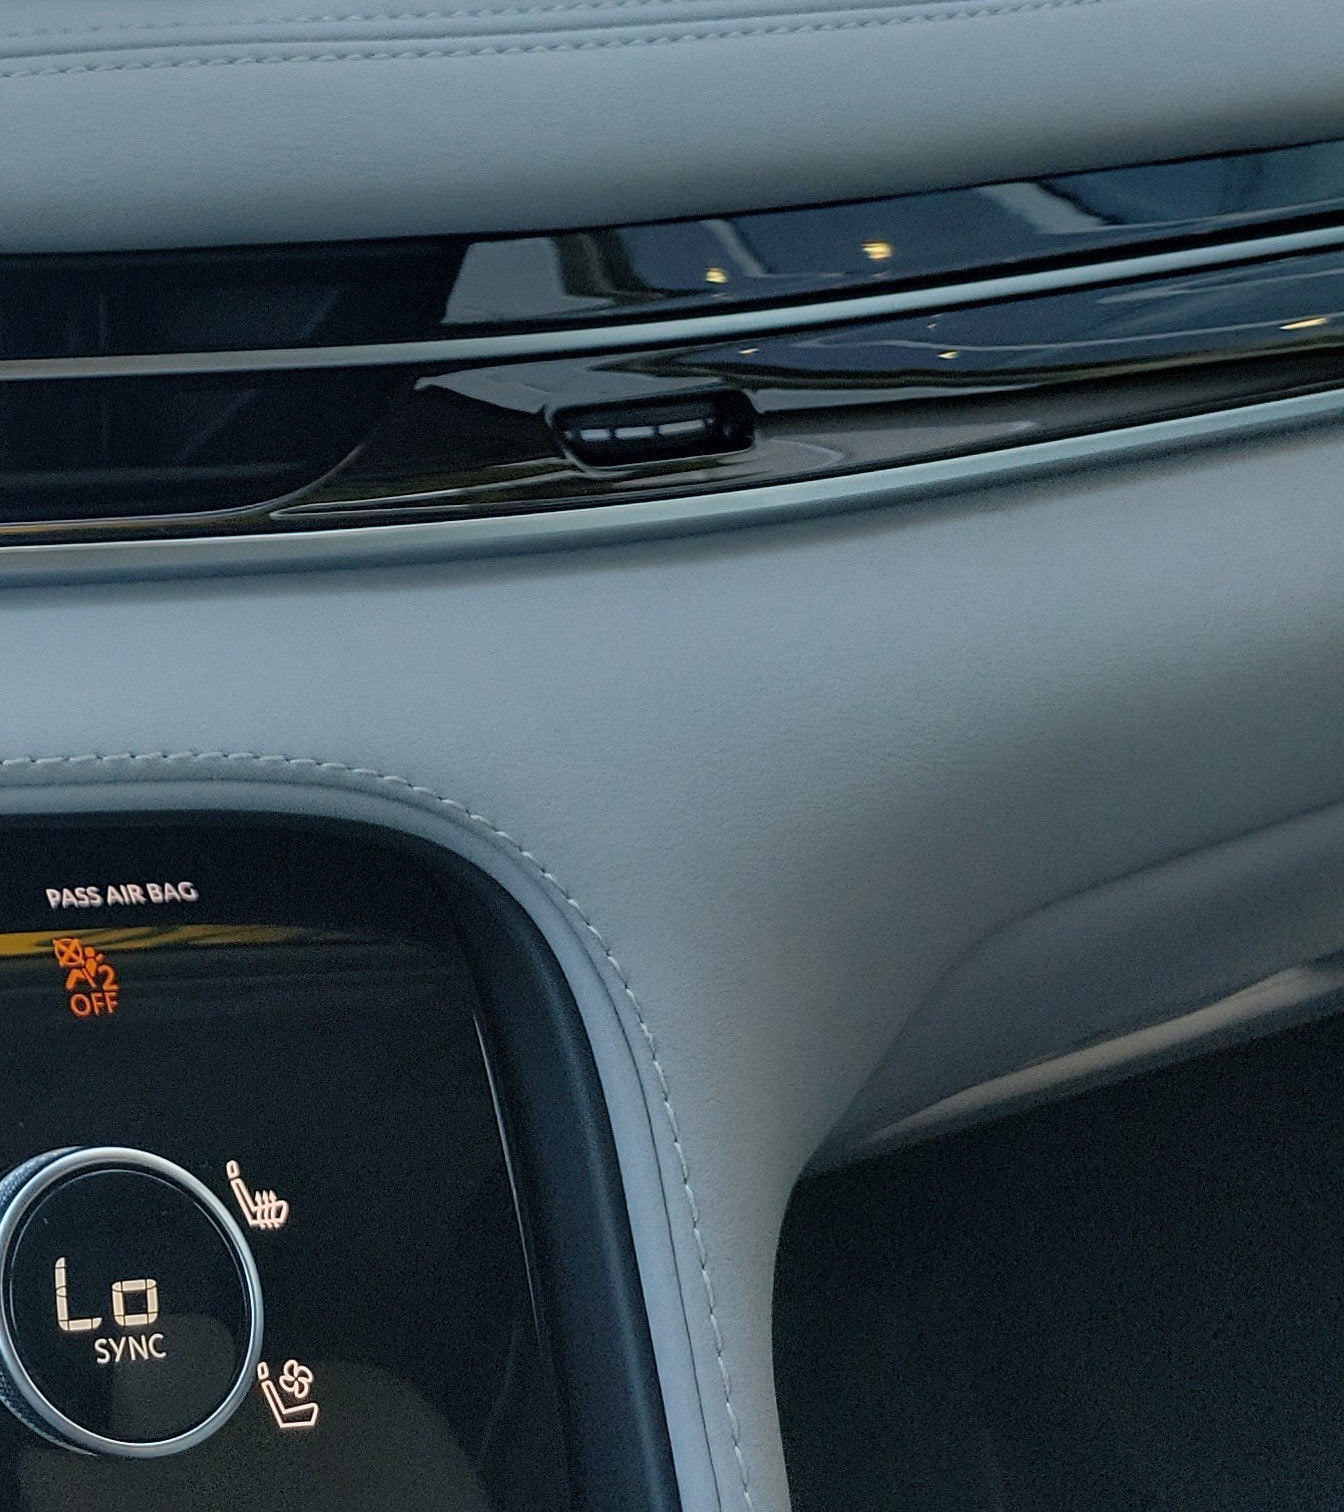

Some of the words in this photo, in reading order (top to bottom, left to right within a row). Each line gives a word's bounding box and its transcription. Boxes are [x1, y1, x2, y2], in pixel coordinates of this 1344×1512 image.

[46, 887, 102, 908] PASS
[106, 884, 146, 905] AIR
[145, 882, 198, 904] BAG
[70, 990, 119, 1018] OFF
[95, 1334, 168, 1364] SYNC
